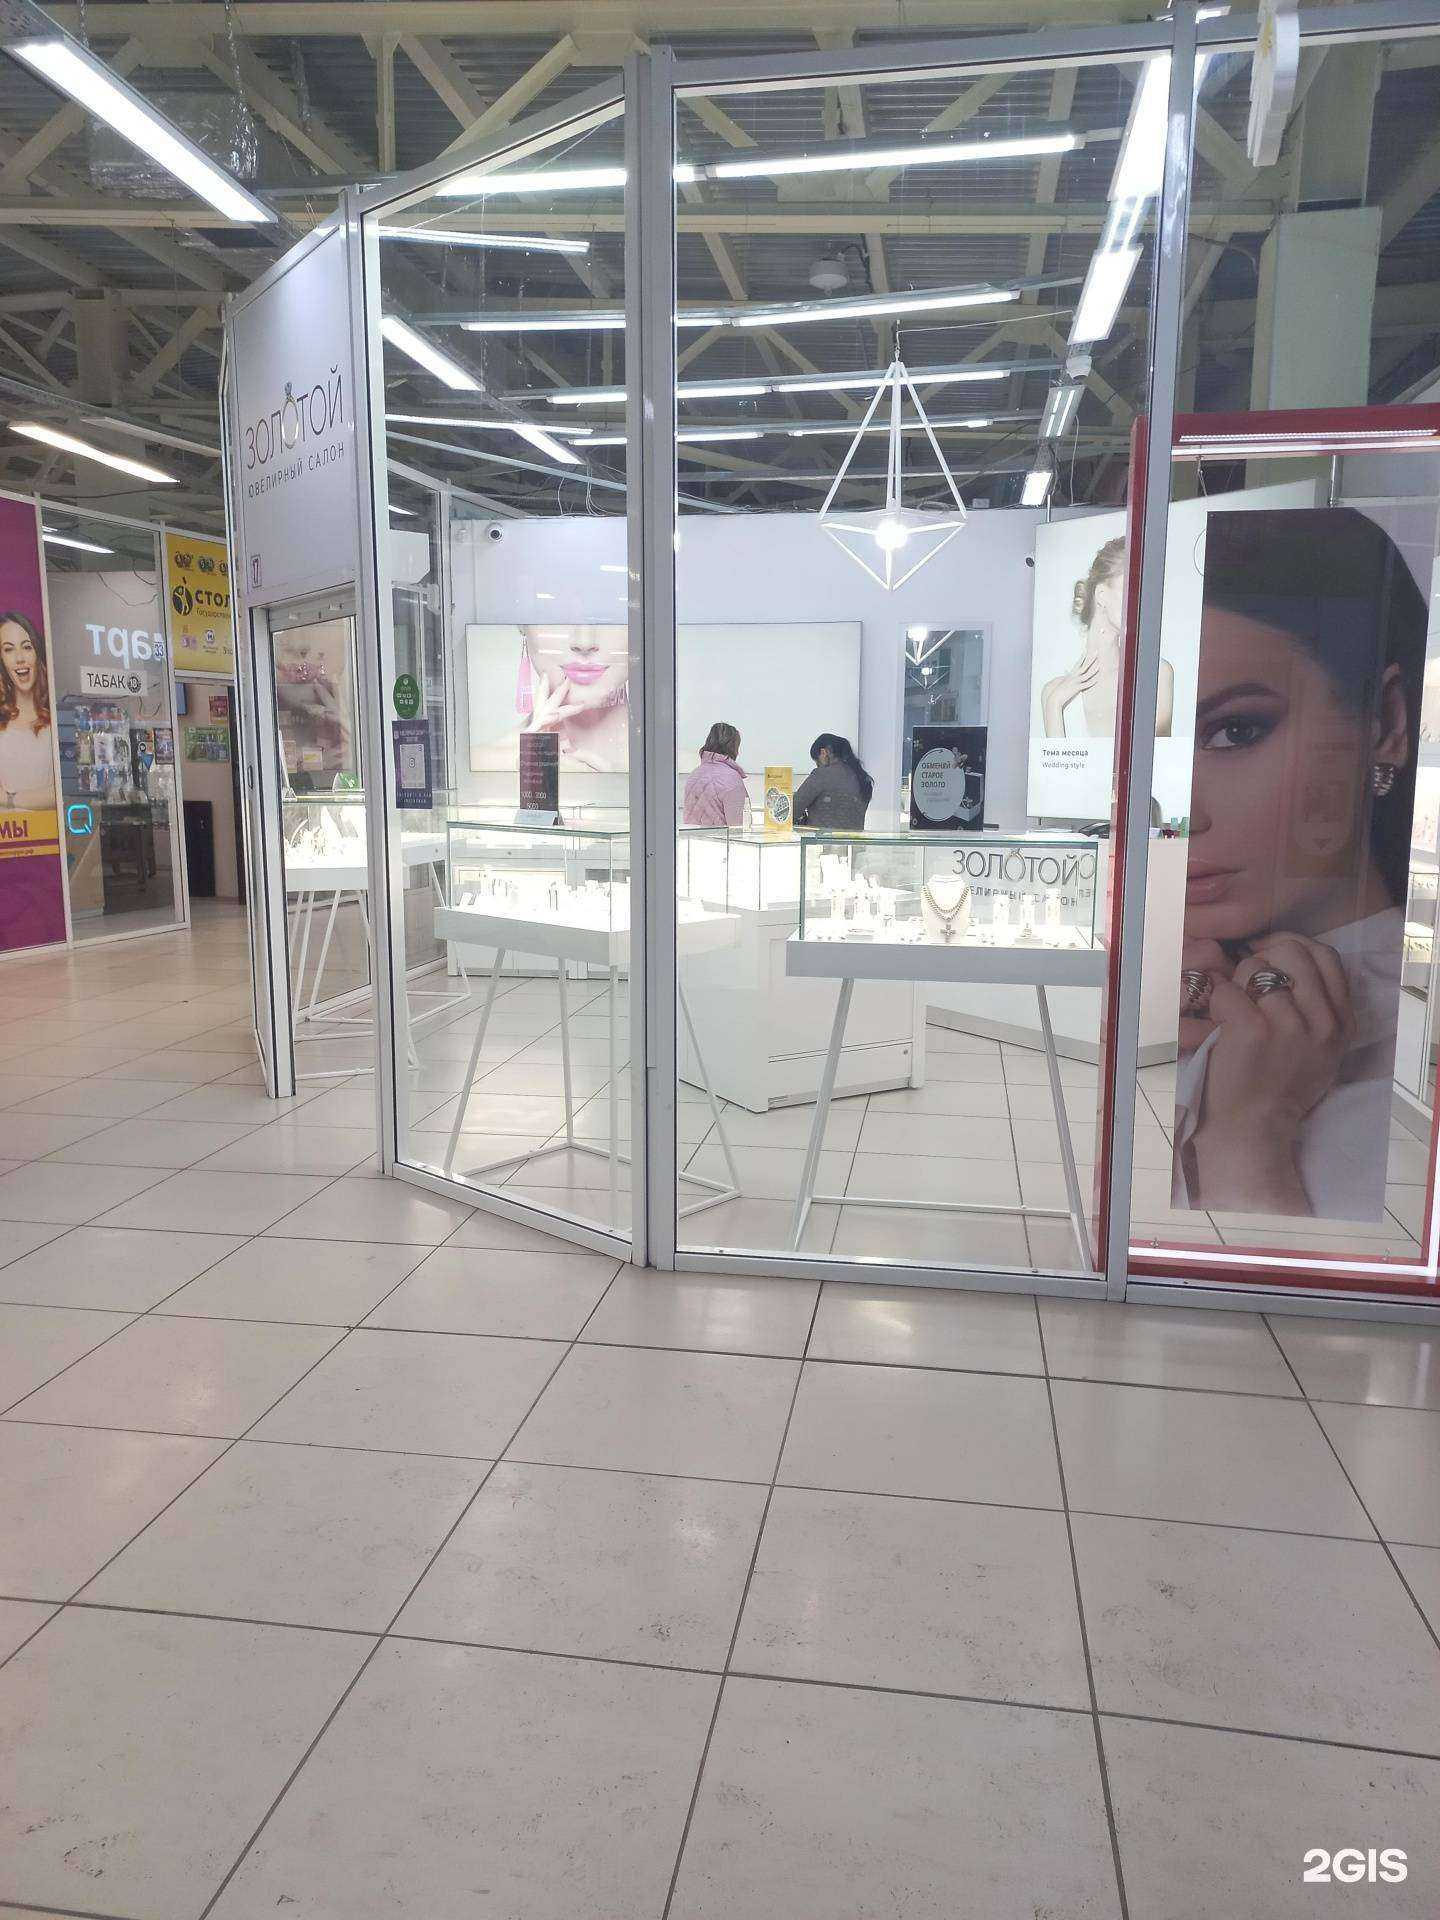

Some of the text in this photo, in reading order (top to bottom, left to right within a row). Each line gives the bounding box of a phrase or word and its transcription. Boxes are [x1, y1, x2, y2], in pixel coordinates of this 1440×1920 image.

[246, 364, 344, 470] ЗОЛОТОЙ
[248, 442, 345, 498] ЮВЕЛИРНЫЙ САЛОН
[87, 673, 126, 689] ТАБАК
[952, 849, 1079, 886] ЗОЛОТОЙ
